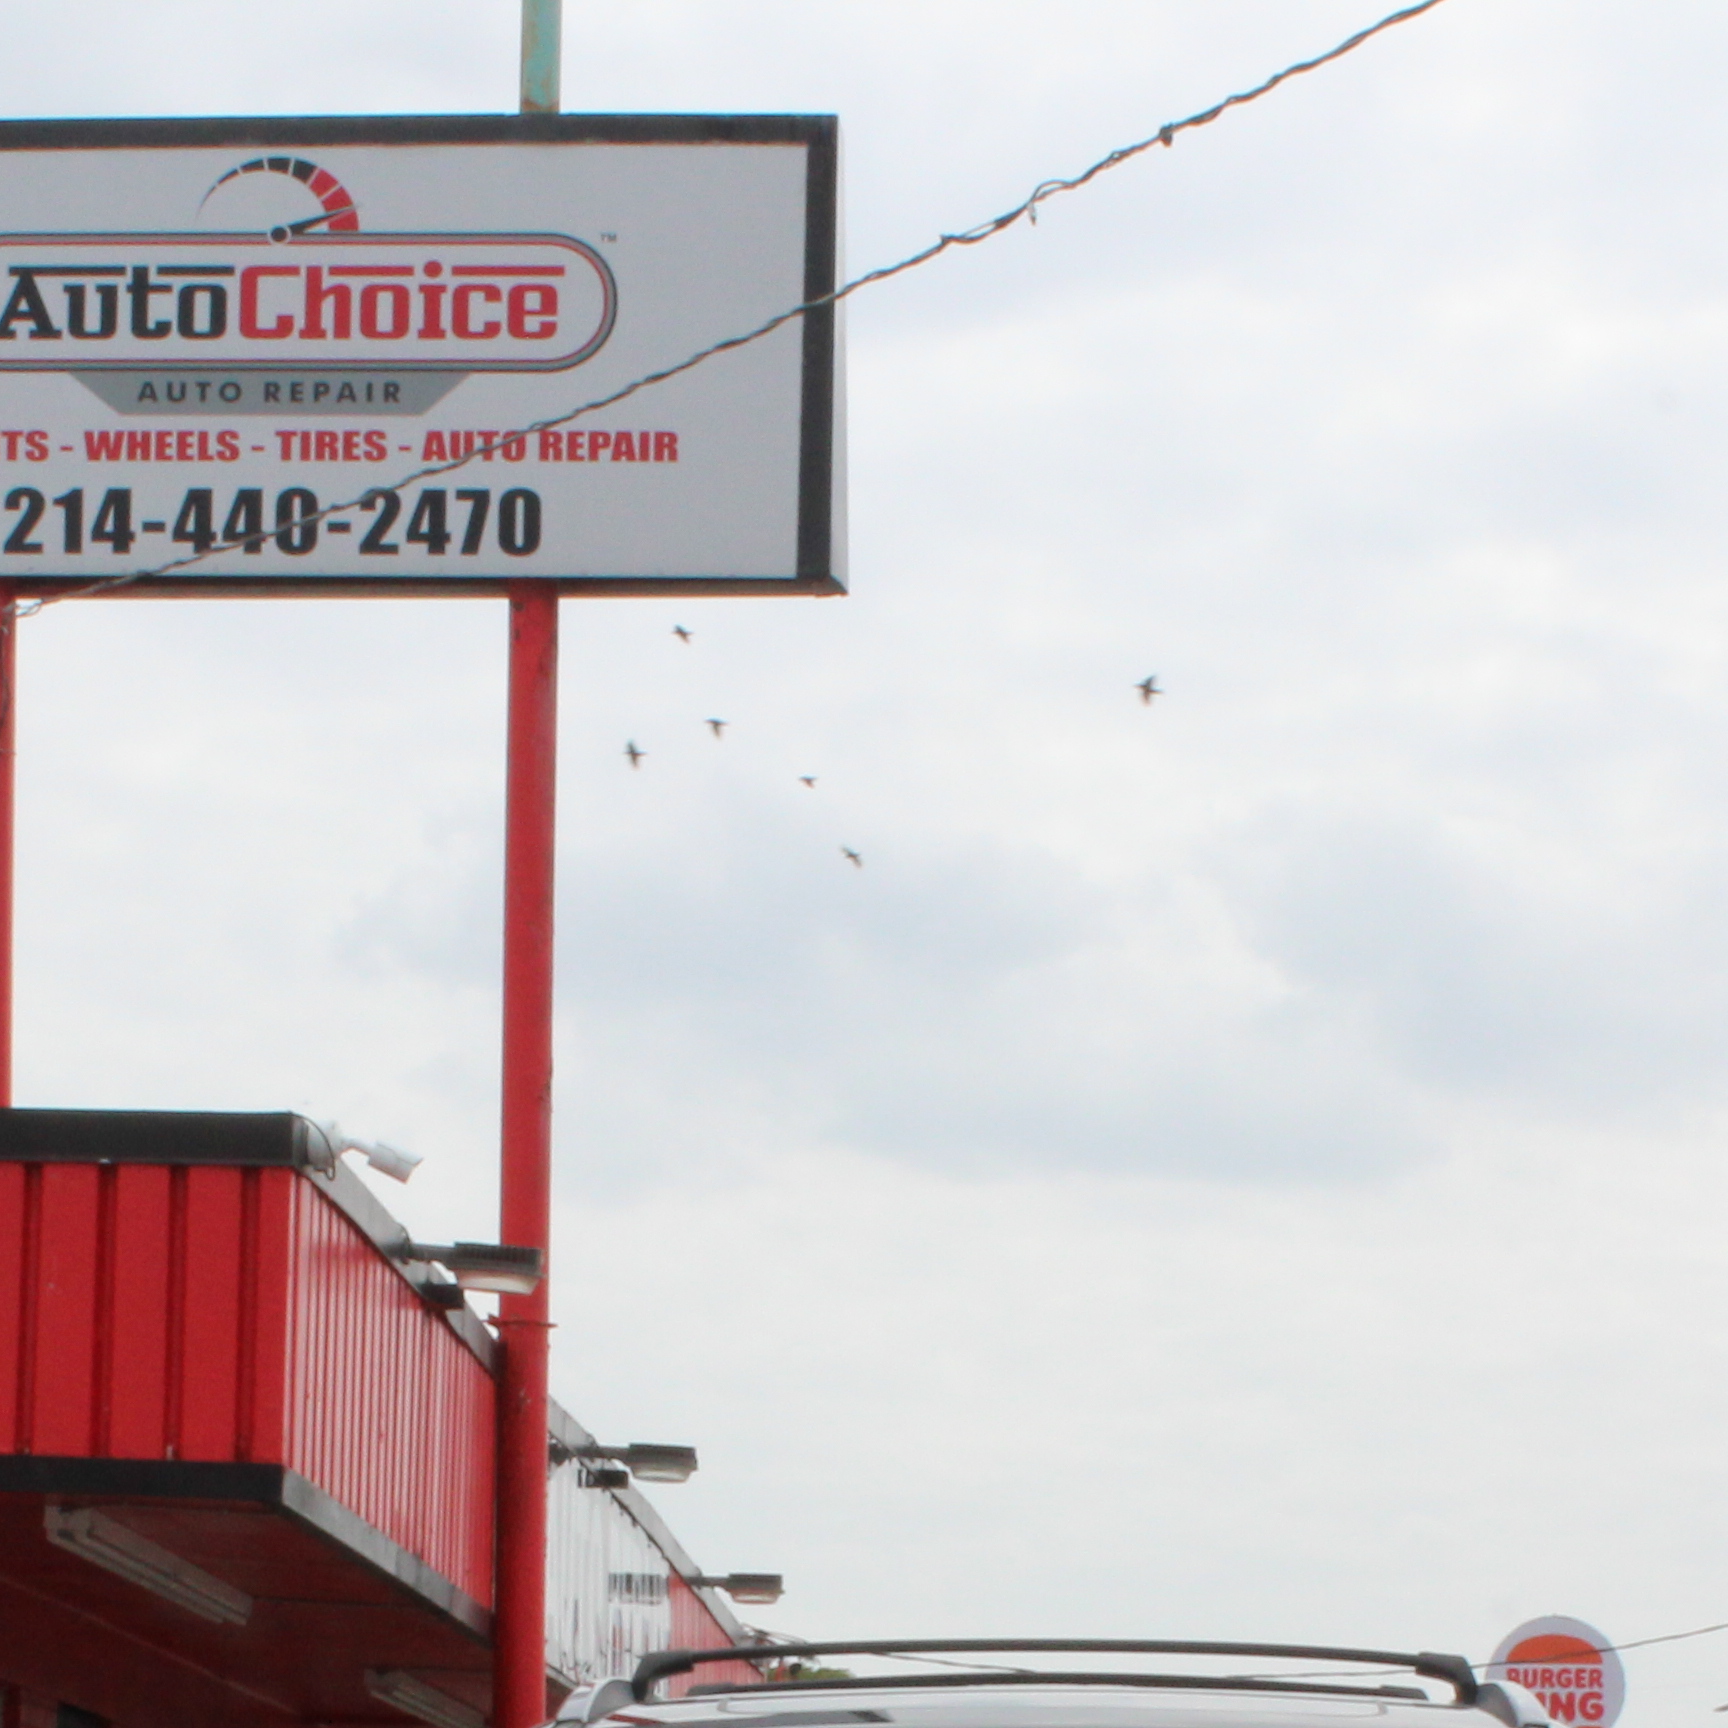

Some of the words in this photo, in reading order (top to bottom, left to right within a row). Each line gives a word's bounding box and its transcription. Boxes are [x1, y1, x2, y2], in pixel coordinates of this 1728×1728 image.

[136, 379, 243, 405] AUTO
[263, 379, 402, 404] REPAIR
[83, 430, 241, 463] WHEELS
[275, 430, 388, 463] TIRES
[422, 430, 529, 463] AUTO
[538, 430, 679, 463] REPAIR
[3, 486, 543, 557] 214-440-2470
[1506, 1667, 1604, 1690] BURGER
[1535, 1690, 1605, 1722] NG
